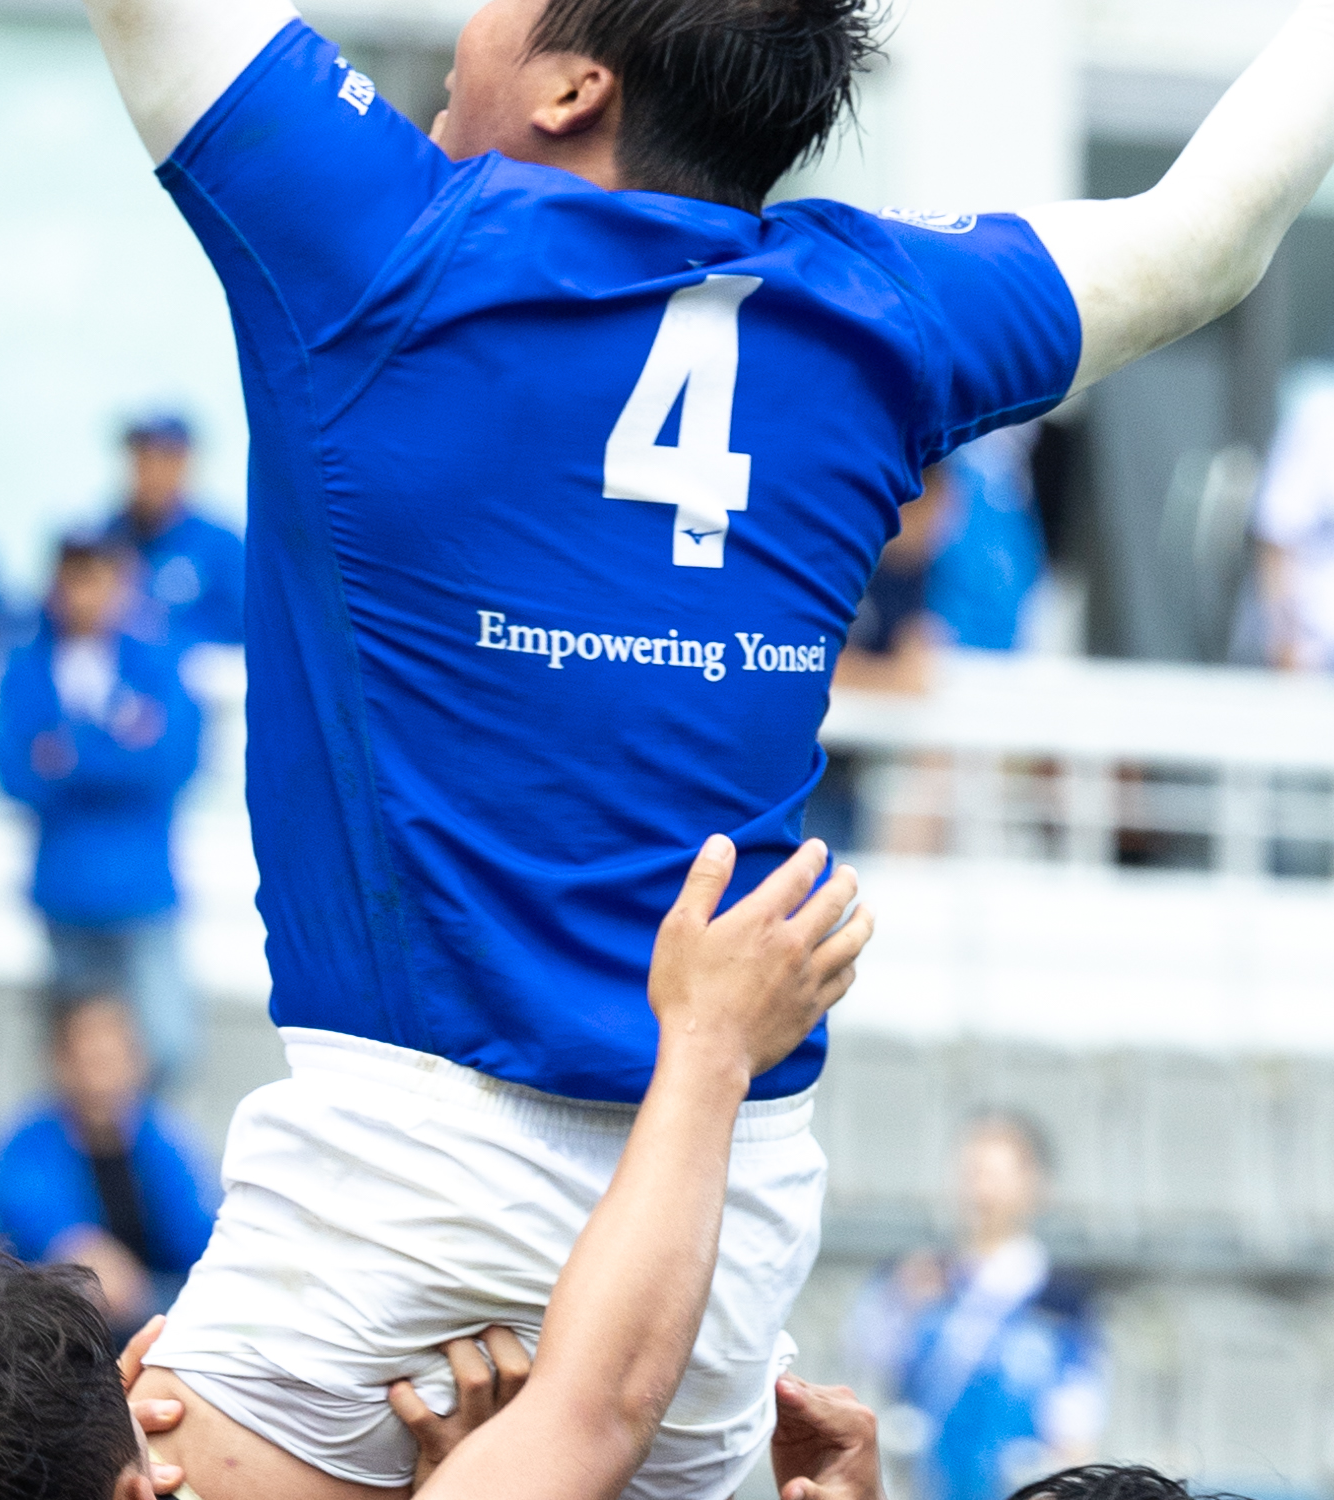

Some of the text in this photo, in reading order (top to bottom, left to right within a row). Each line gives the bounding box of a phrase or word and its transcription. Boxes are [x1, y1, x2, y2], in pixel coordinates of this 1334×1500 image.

[601, 275, 763, 569] 4
[476, 610, 826, 680] Empowering Yonsei
